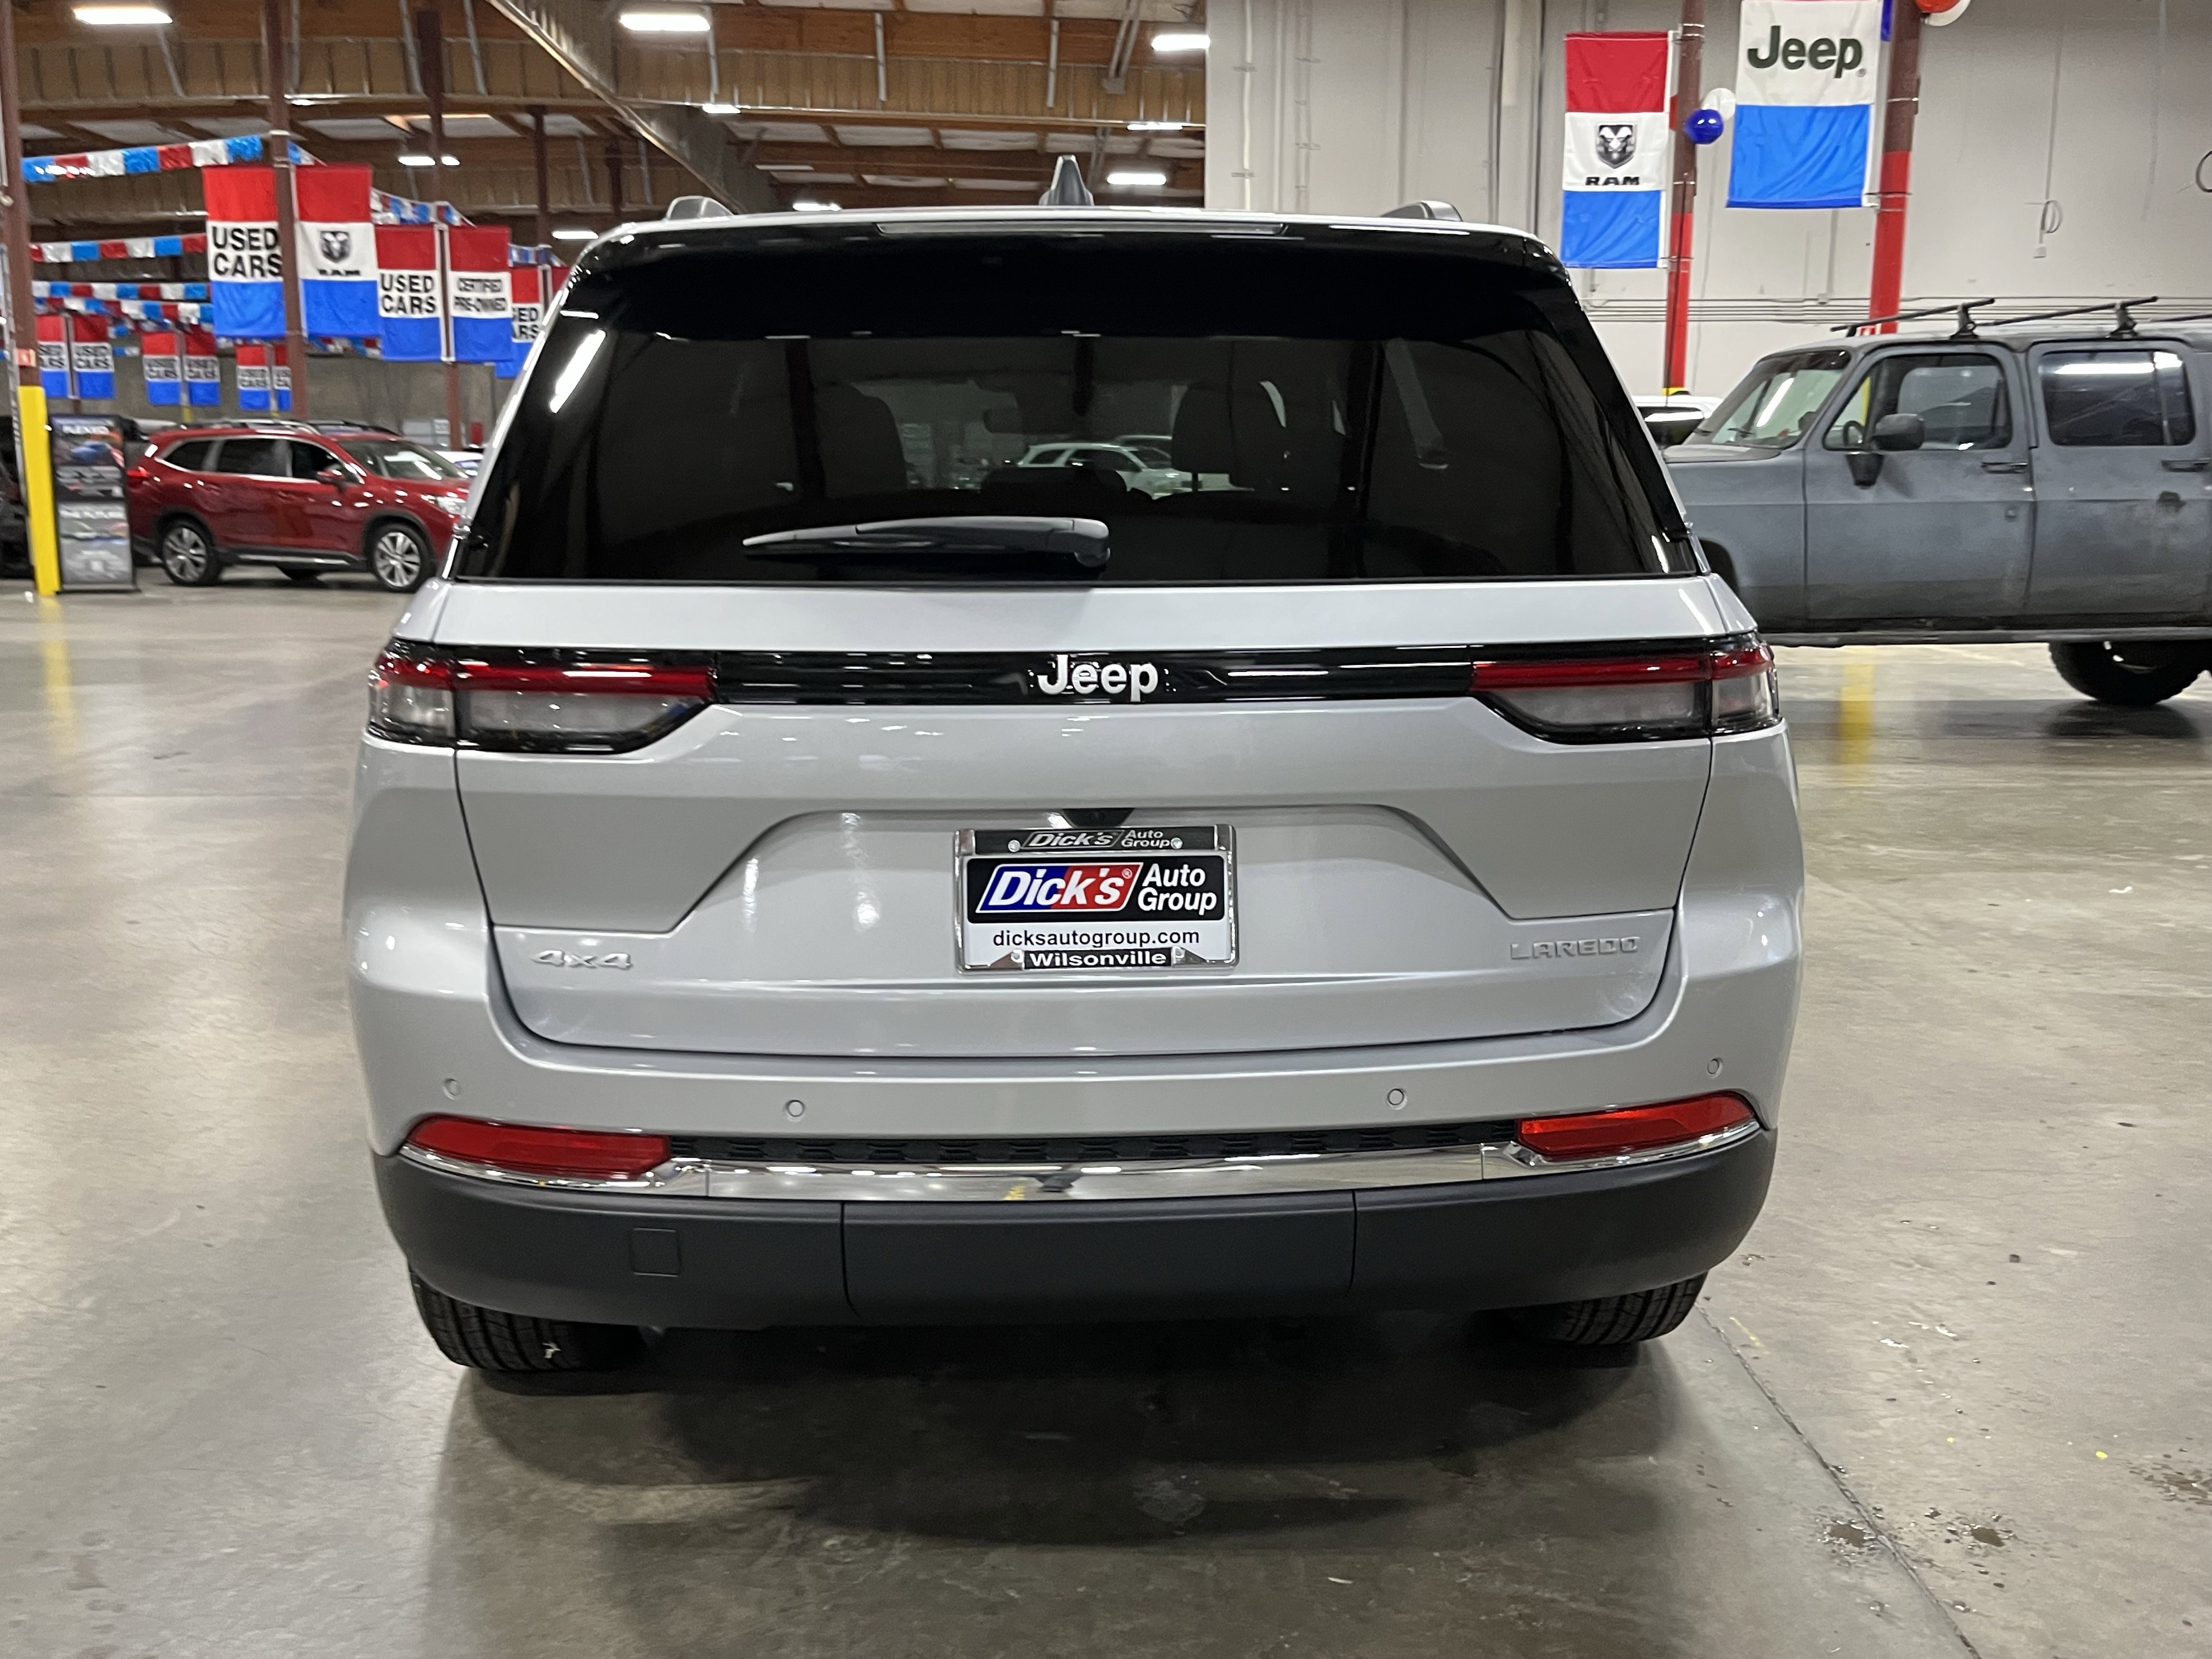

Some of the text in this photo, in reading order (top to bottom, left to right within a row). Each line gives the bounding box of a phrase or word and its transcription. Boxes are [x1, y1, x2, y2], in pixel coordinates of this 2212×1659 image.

[1747, 25, 1863, 78] Jeep
[1585, 176, 1640, 185] RAM
[212, 227, 279, 251] USED
[214, 253, 282, 277] CARS
[380, 273, 434, 293] USED
[381, 295, 436, 314] CARS
[1037, 654, 1158, 702] Jeep
[1029, 832, 1113, 847] Dick's
[1121, 838, 1170, 848] Group
[1125, 830, 1164, 839] Auto
[1142, 863, 1205, 887] Auto
[988, 868, 1125, 906] Dick's
[1138, 887, 1217, 915] Group
[993, 930, 1200, 947] dicksautogroup.com
[1510, 936, 1641, 960] LAREDO
[1029, 951, 1167, 967] Wilsonville
